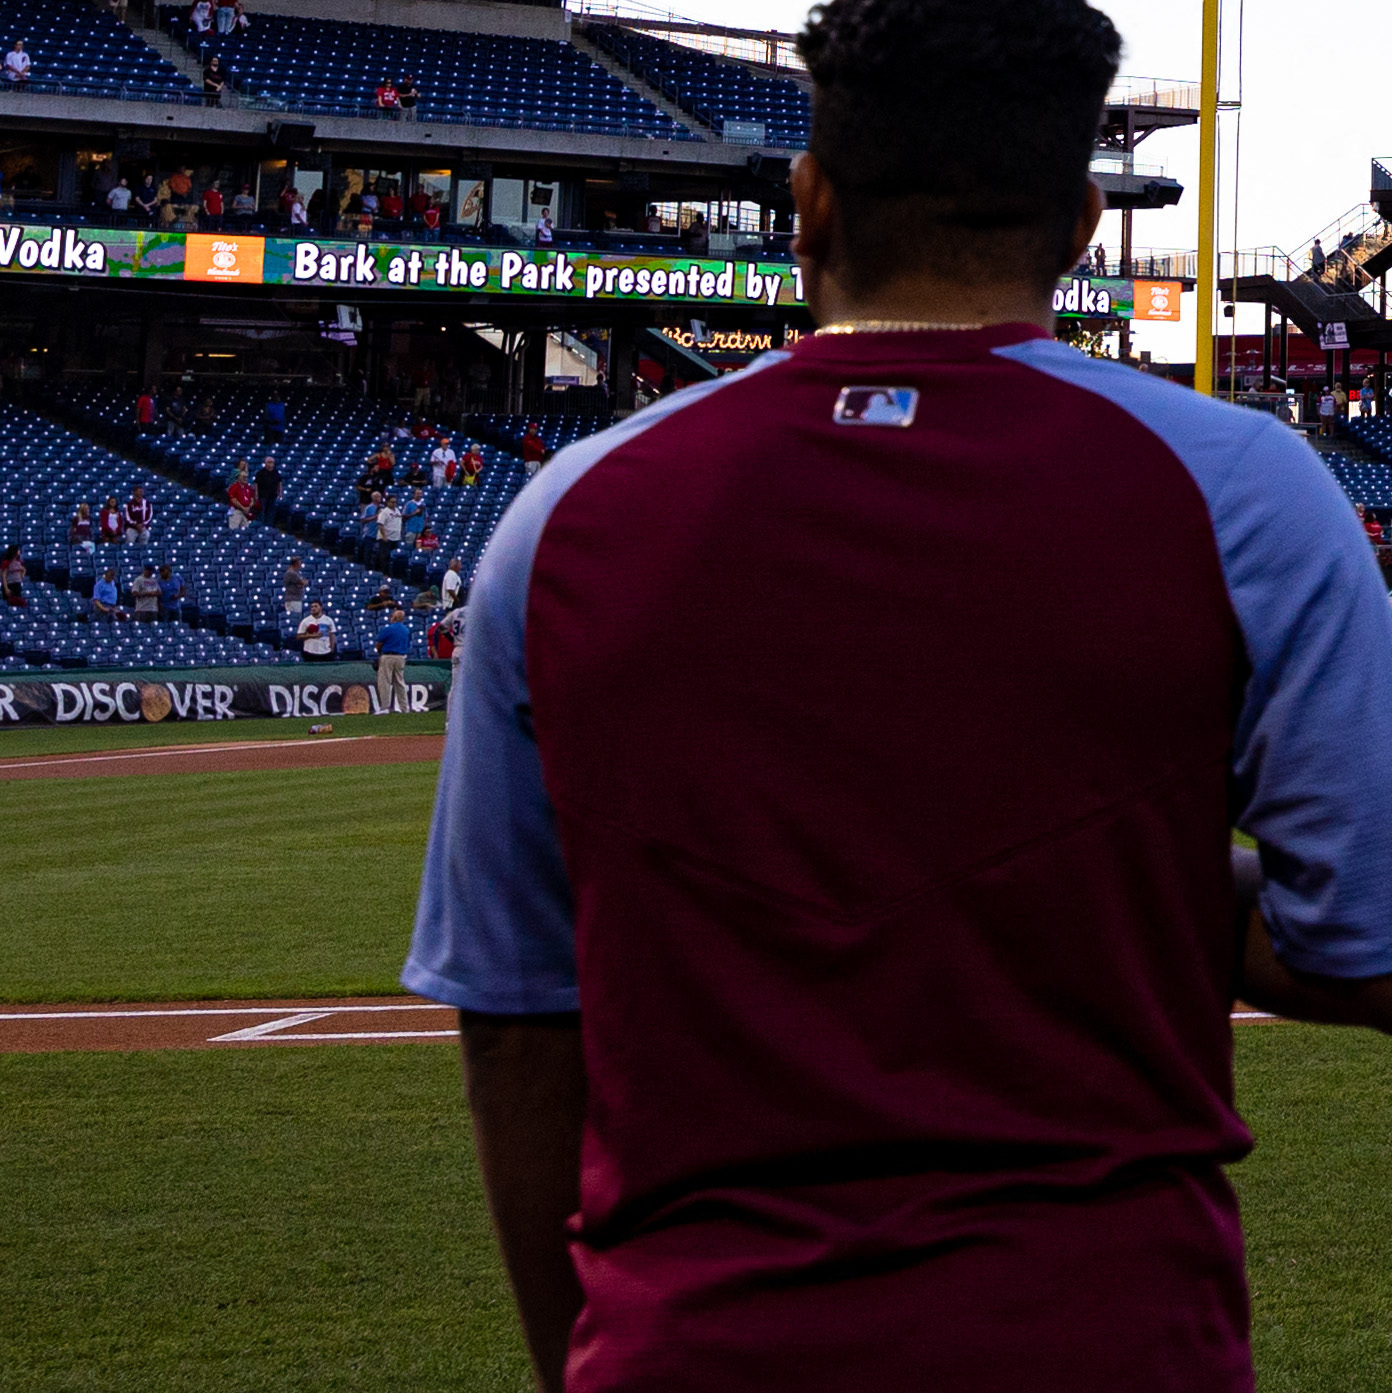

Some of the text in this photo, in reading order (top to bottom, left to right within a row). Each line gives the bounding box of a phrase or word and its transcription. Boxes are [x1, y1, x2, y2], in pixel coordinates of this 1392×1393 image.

[0, 227, 106, 271] Vodka
[293, 242, 376, 285] Bark
[387, 250, 422, 286] at
[434, 248, 487, 288] the
[500, 251, 574, 291] Park
[586, 261, 734, 299] presented
[746, 263, 782, 306] by
[1052, 278, 1111, 314] odka
[51, 682, 236, 722] DISCOVER
[268, 684, 430, 718] DISCOR
